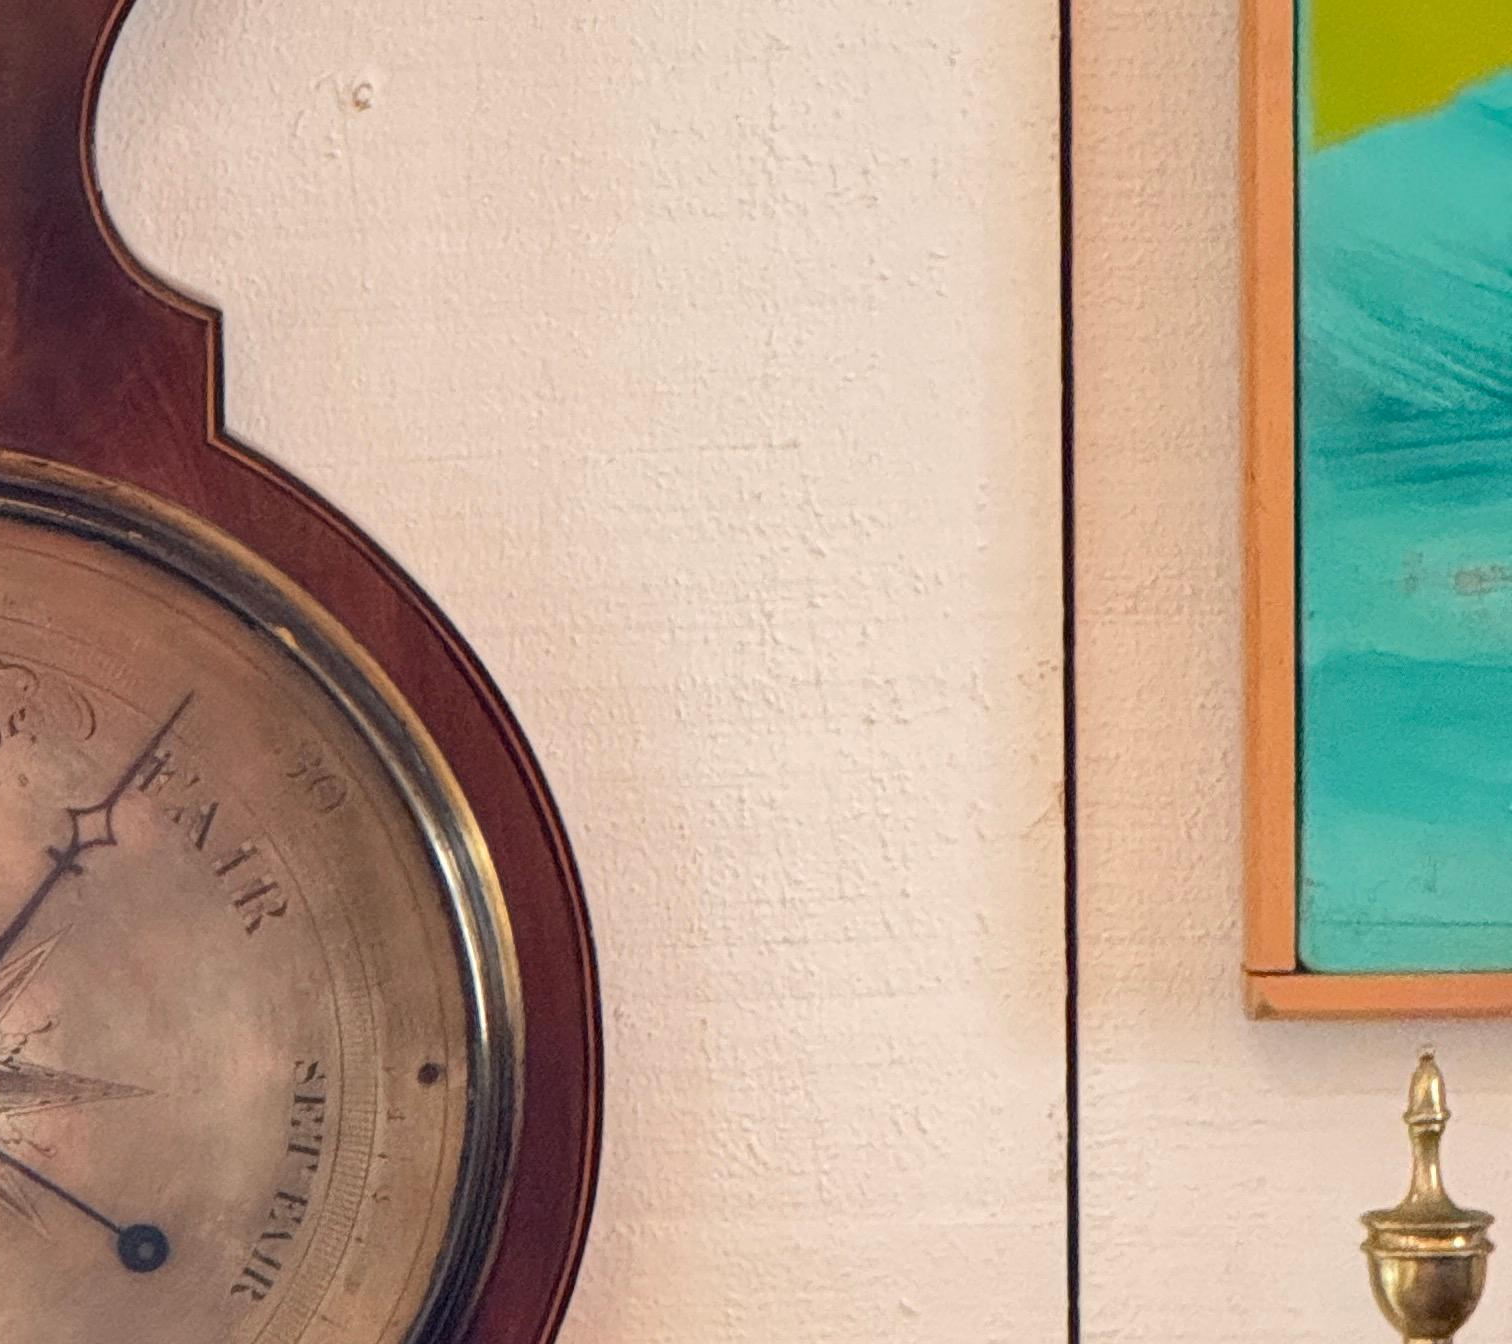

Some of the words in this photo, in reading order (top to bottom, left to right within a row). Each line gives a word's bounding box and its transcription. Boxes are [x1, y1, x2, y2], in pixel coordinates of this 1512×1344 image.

[138, 749, 289, 937] FAIR
[287, 1058, 326, 1176] SET
[230, 1187, 312, 1303] FAIR
